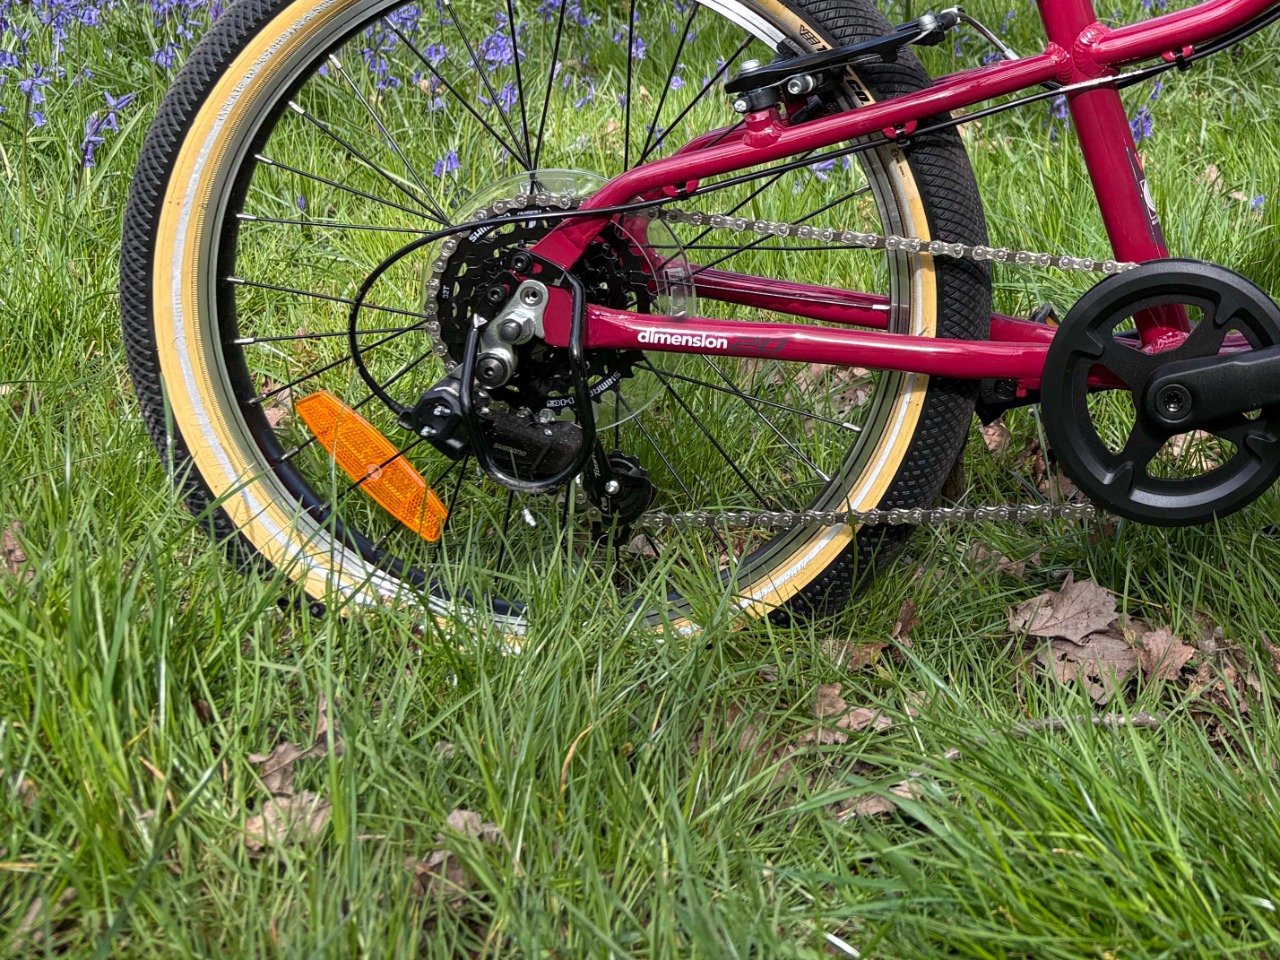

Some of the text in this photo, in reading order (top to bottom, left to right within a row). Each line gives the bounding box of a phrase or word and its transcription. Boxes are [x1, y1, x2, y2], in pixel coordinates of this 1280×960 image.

[441, 285, 450, 299] 32T
[637, 328, 788, 354] dimension 20
